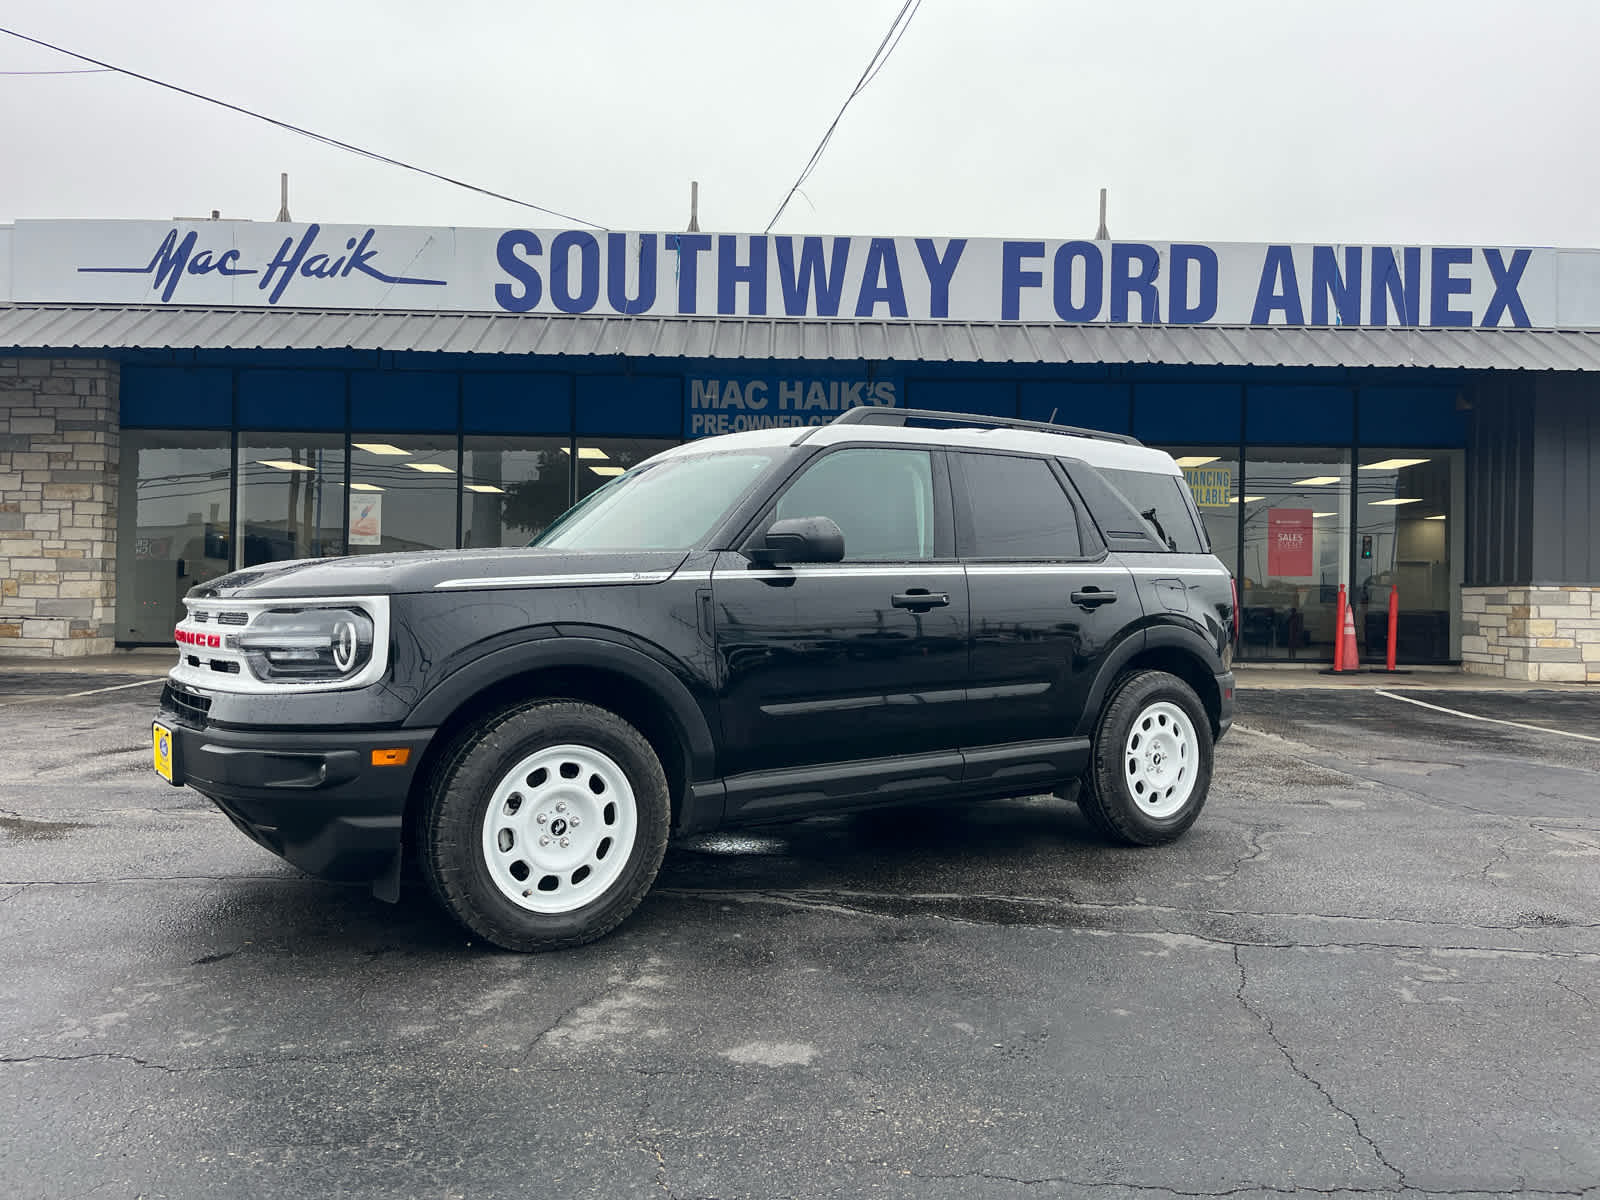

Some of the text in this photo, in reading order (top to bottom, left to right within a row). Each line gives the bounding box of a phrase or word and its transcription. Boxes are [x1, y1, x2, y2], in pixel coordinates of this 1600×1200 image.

[78, 223, 448, 304] Mac Haik
[494, 229, 1533, 328] SOUTHWAY FORD ANNEX
[691, 380, 896, 410] MAC HAIK'S
[1277, 533, 1304, 542] SALES
